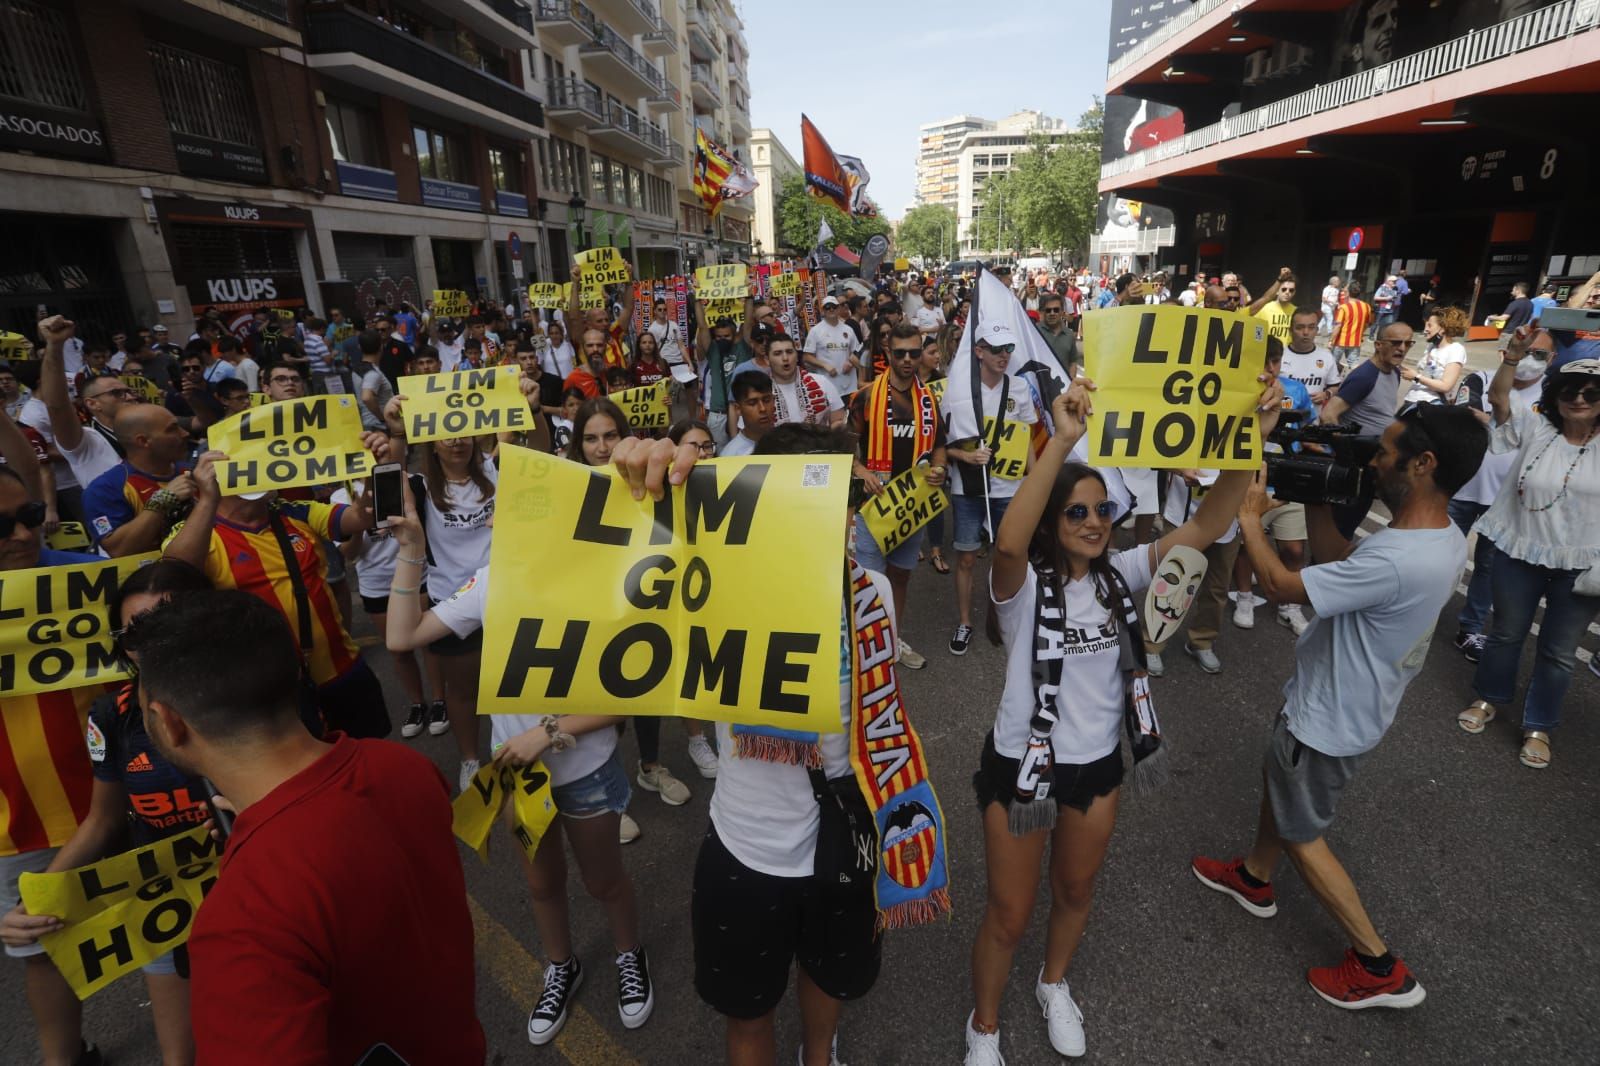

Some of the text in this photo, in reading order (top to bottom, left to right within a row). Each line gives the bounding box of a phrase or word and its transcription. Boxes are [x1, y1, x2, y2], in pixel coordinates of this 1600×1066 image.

[0, 114, 102, 146] ASOCIADOS
[1540, 148, 1557, 180] 8
[224, 206, 260, 220] KUUPS
[1216, 213, 1227, 232] 12
[586, 249, 613, 263] LIM
[584, 270, 626, 284] HOME
[594, 263, 609, 272] GO
[705, 265, 736, 279] LIM
[776, 274, 794, 283] LIM
[206, 277, 278, 302] KUUPS
[533, 284, 556, 294] LIM
[698, 285, 745, 297] HOME
[713, 279, 729, 288] GO
[774, 287, 801, 297] HOME
[441, 291, 460, 300] LIM
[436, 306, 468, 315] HOME
[1272, 314, 1290, 326] LIM
[1131, 312, 1245, 369] LIM
[1270, 326, 1289, 338] OUT
[426, 368, 496, 393] LIM
[1162, 370, 1222, 406] GO
[445, 392, 485, 409] GO
[622, 387, 656, 403] LIM
[628, 412, 666, 427] OME
[630, 403, 649, 414] GO
[240, 399, 327, 441] LIM
[412, 407, 525, 438] HOME
[892, 420, 915, 438] wi
[982, 420, 1016, 442] IM
[267, 435, 316, 457] GO
[1098, 411, 1254, 460] HOME
[227, 451, 367, 489] HOME
[989, 458, 1022, 477] ME
[572, 463, 772, 547] LIM
[874, 471, 918, 518] LIM
[895, 496, 916, 521] GO
[883, 490, 943, 553] HOME
[0, 566, 118, 620] LIM
[623, 554, 712, 613] GO
[27, 612, 101, 645] GO
[0, 641, 128, 692] OM
[496, 617, 821, 715] HOME
[851, 560, 912, 791] VALEN
[79, 835, 226, 901] LIM
[135, 861, 213, 901] GO
